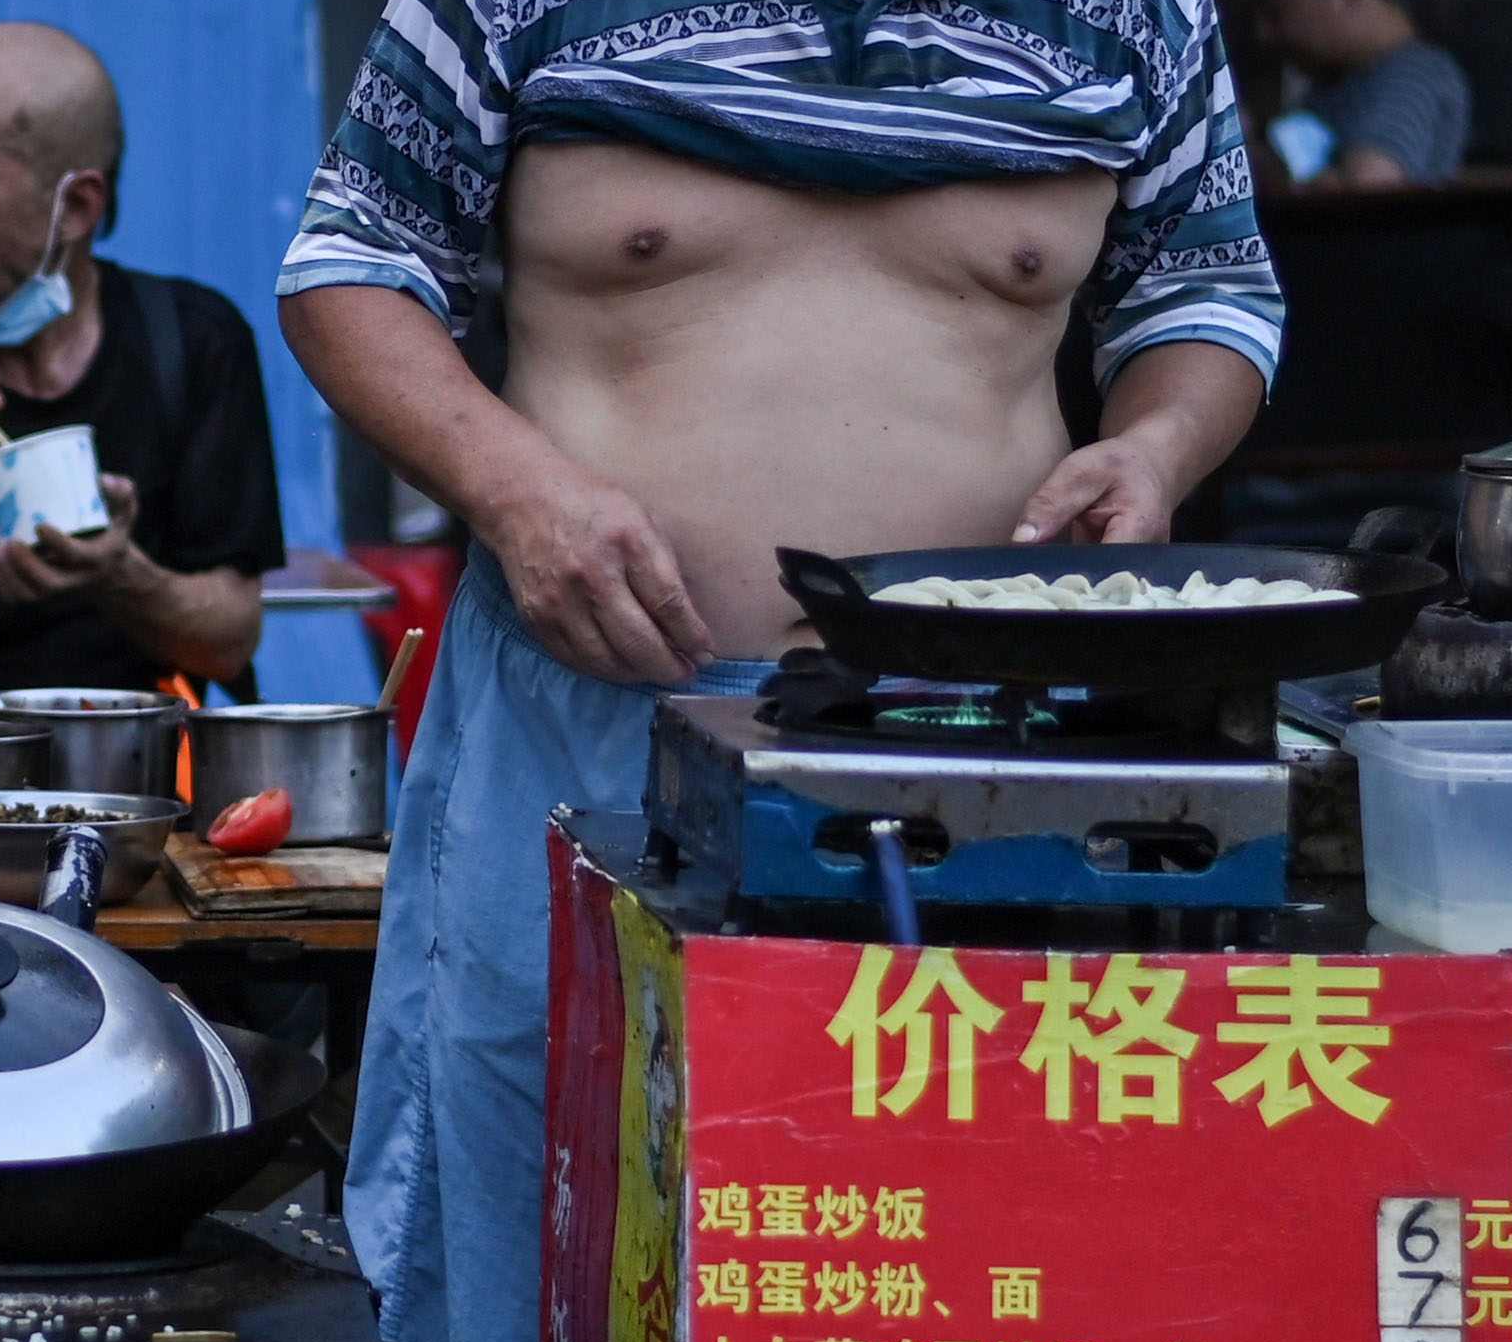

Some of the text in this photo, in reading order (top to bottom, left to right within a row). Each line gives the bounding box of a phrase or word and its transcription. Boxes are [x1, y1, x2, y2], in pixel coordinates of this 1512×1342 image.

[828, 946, 1392, 1127] 价格表
[698, 1184, 926, 1239] 鸡蛋炒饭
